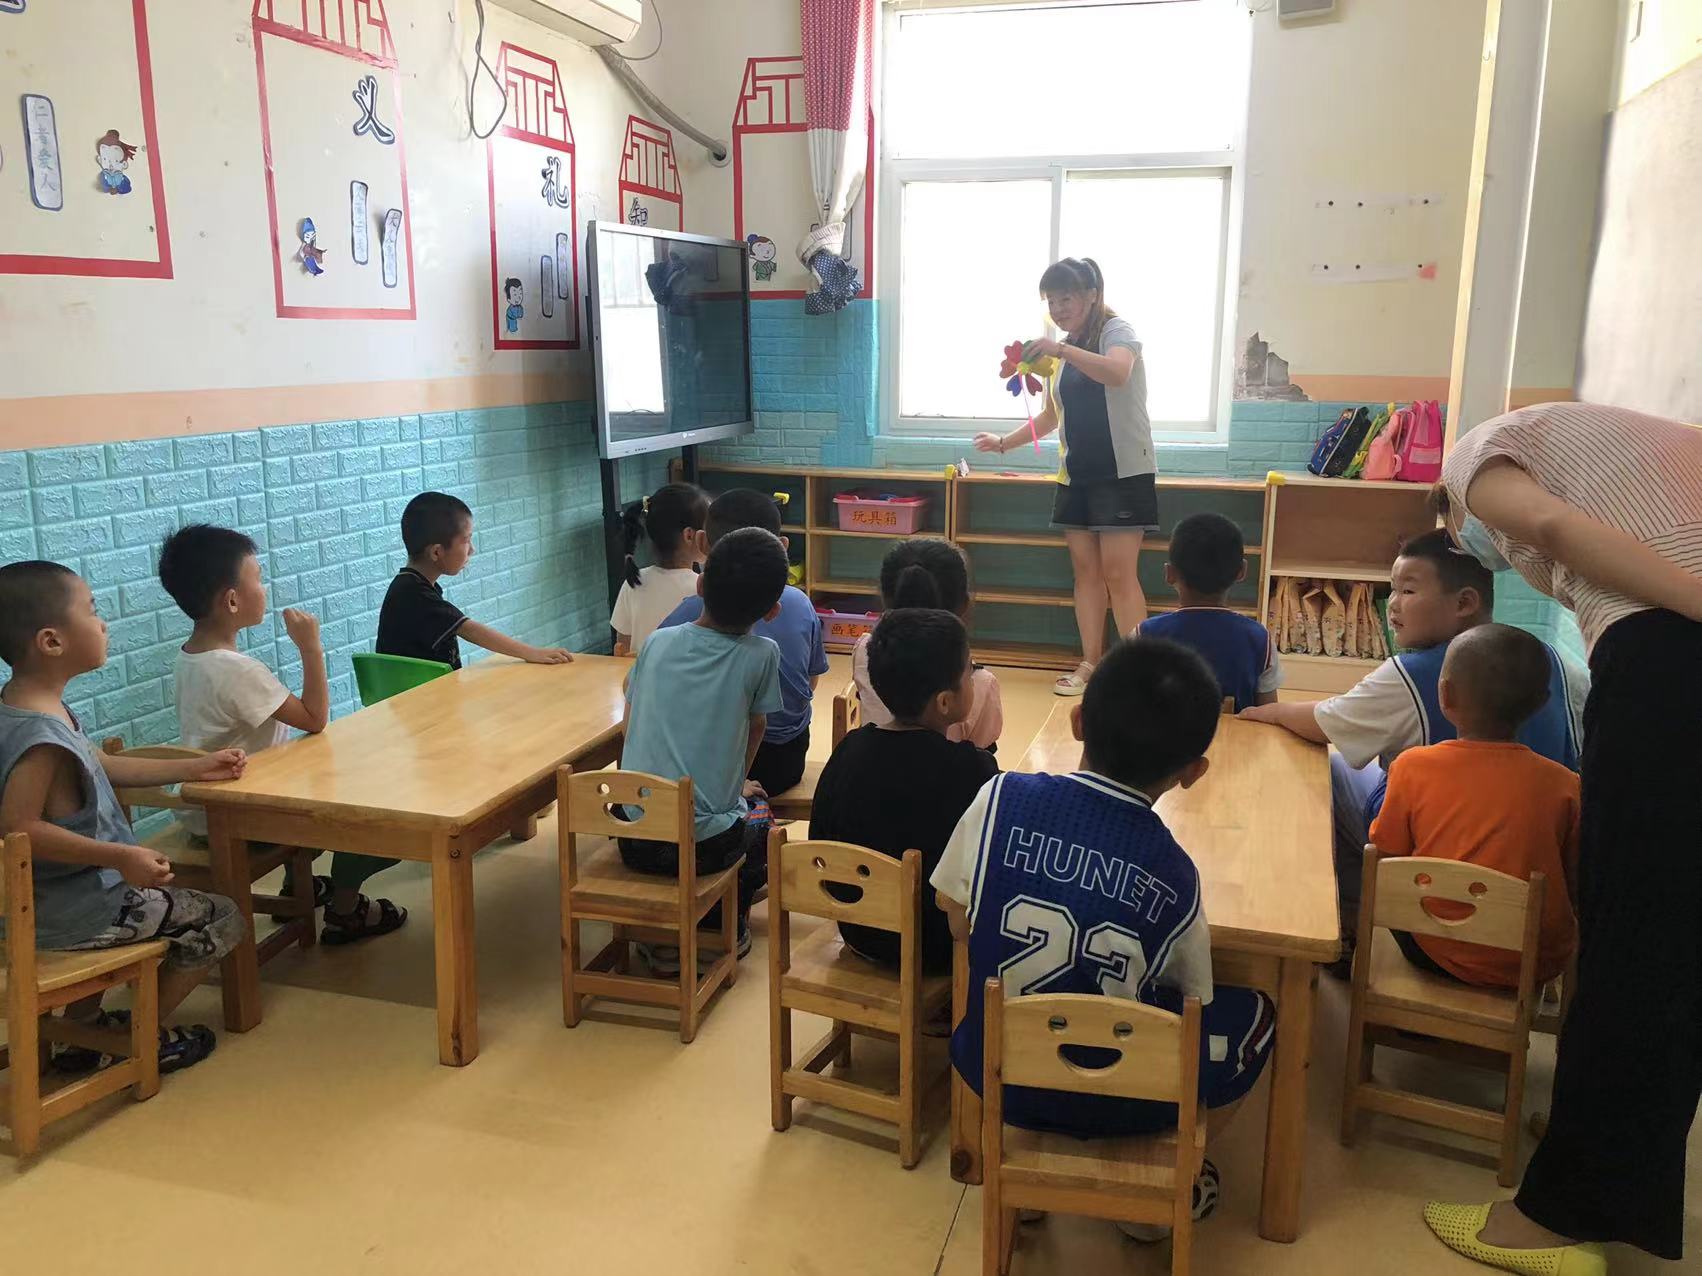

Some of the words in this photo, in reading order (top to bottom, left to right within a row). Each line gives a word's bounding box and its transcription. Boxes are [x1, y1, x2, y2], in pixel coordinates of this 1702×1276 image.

[541, 156, 569, 209] 礼
[852, 510, 897, 526] 玩具箱
[1004, 826, 1178, 924] HUNET
[998, 894, 1147, 1002] 23
